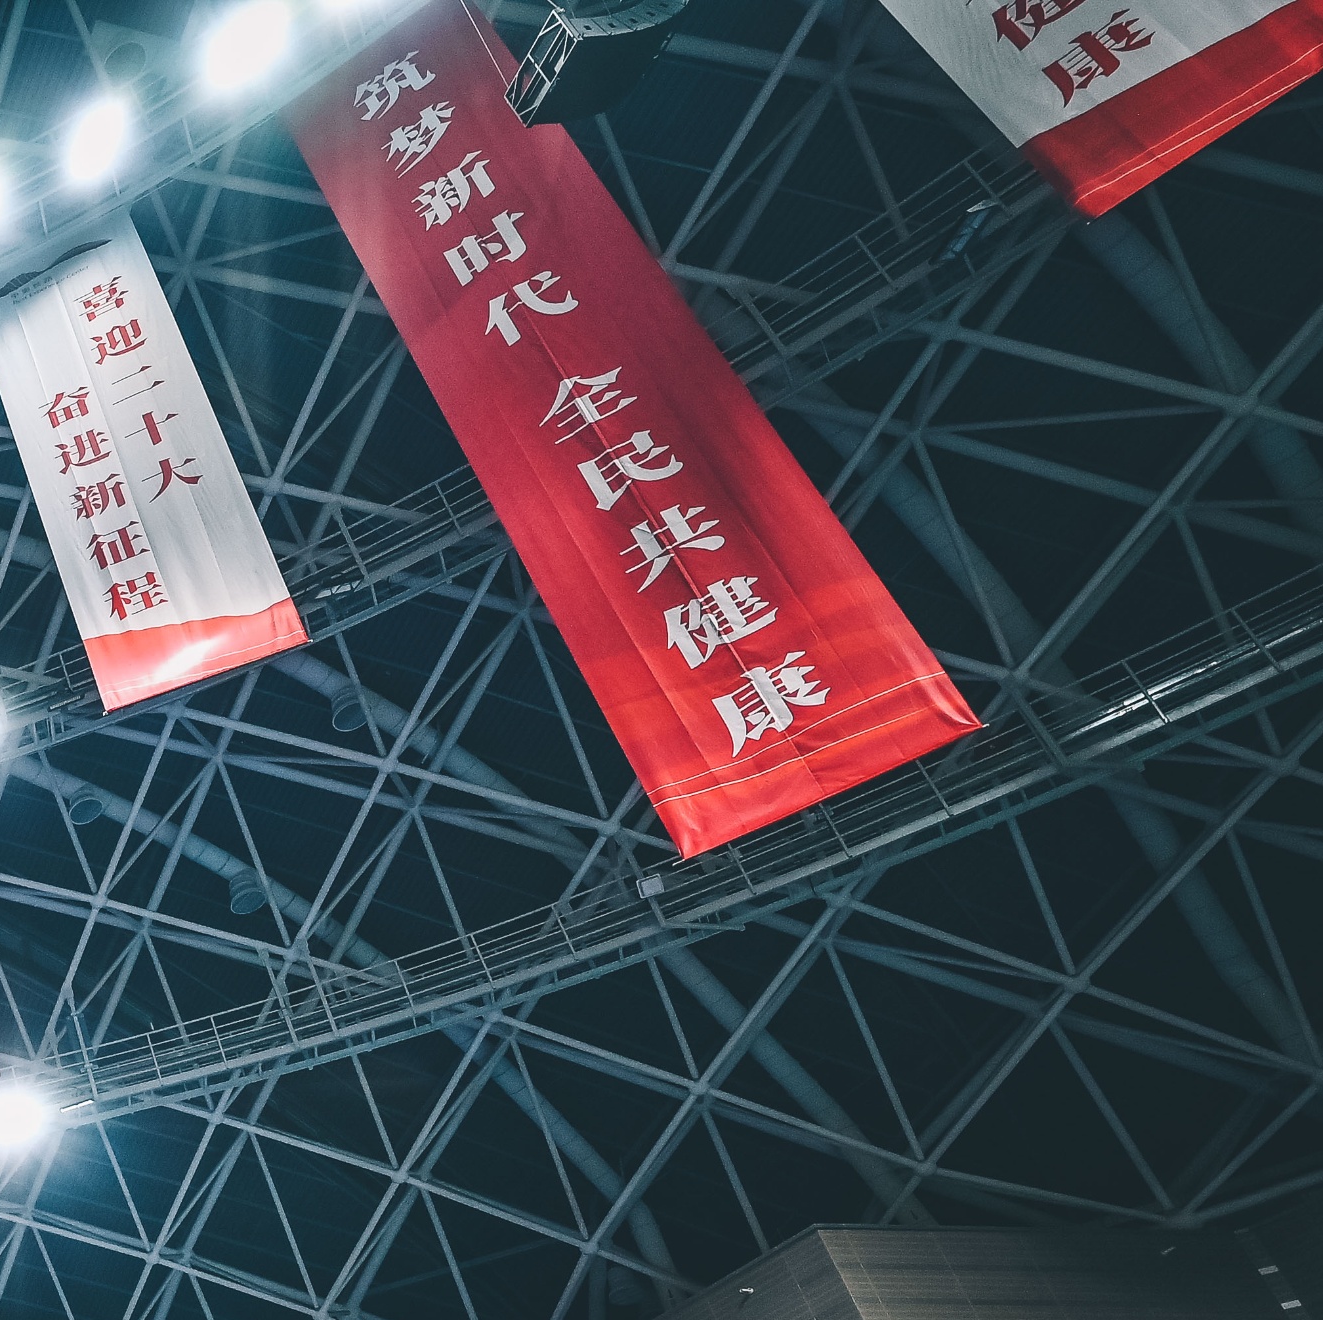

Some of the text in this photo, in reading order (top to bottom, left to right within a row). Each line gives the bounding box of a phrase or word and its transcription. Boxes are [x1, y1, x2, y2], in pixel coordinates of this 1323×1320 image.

[38, 385, 170, 622] 奋进新征程
[73, 274, 205, 505] 喜迎二十大
[351, 49, 833, 759] 筑梦新时代 全民共健康
